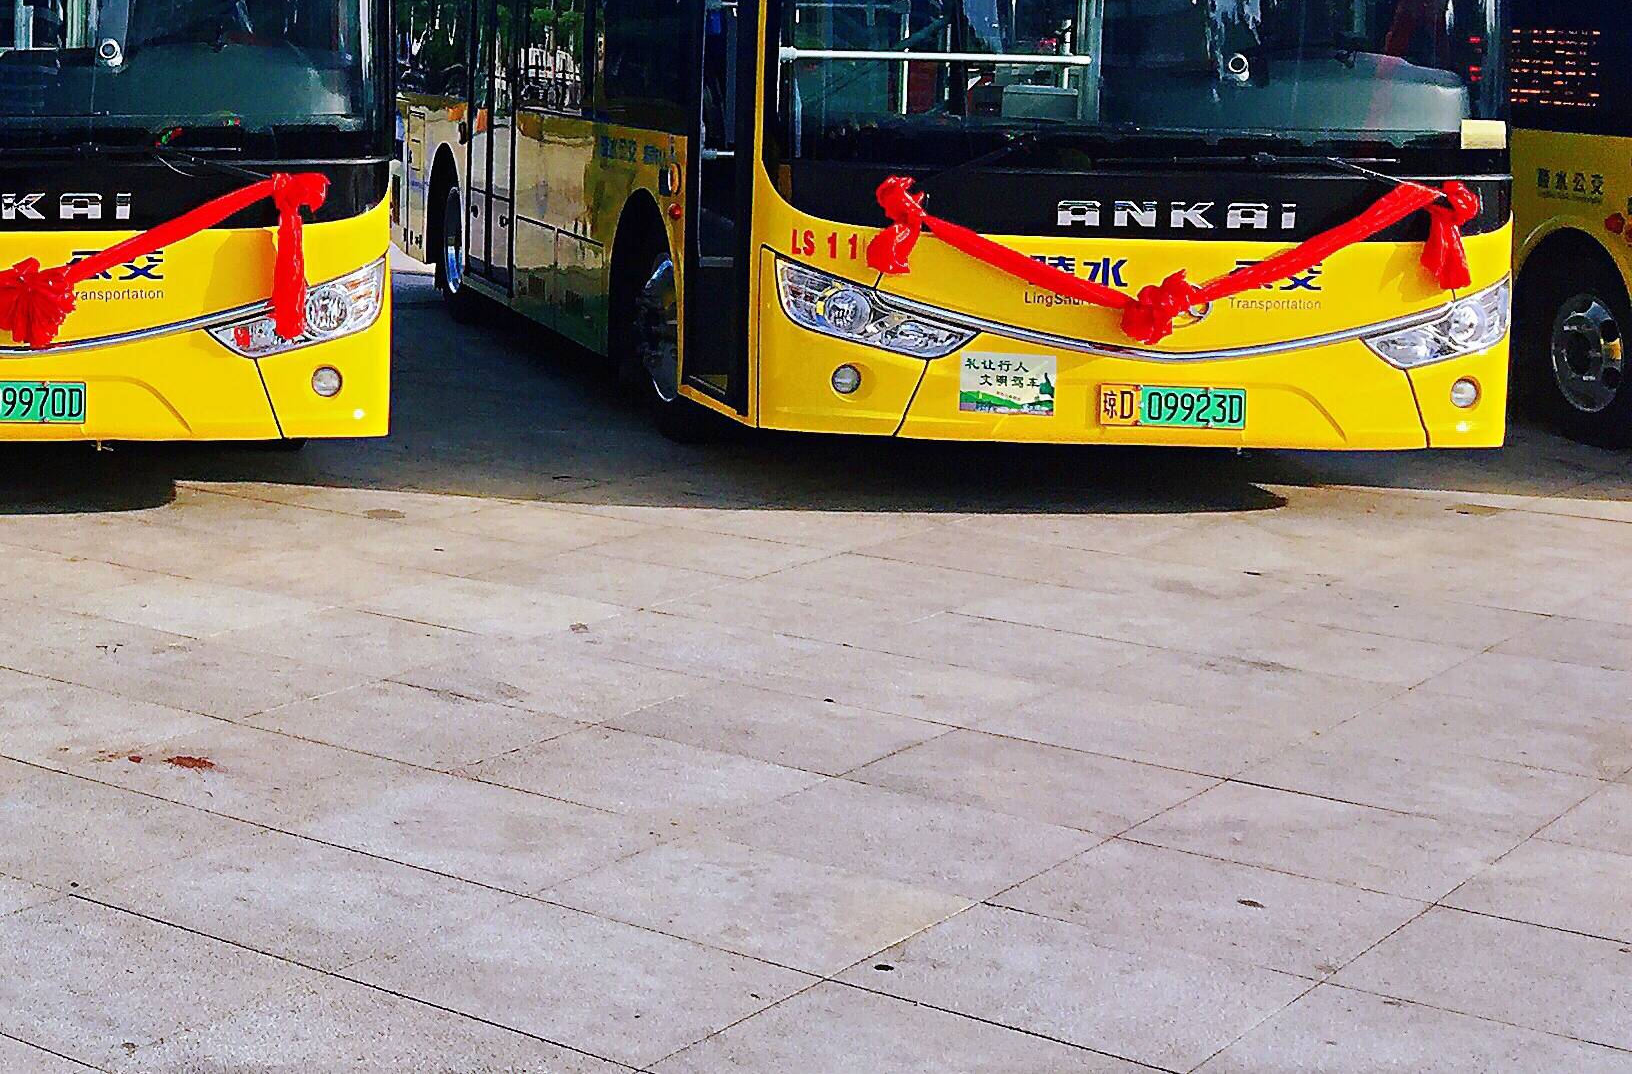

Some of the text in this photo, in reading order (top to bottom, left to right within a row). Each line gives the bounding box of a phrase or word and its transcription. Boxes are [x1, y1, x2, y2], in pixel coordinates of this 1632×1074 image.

[791, 229, 866, 260] LS 11
[74, 288, 165, 303] ransportation
[1229, 296, 1322, 313] Transportation
[964, 357, 1029, 373] 礼让行人
[979, 373, 1041, 389] 文明驾车
[1102, 390, 1243, 424] 琼D 09923D
